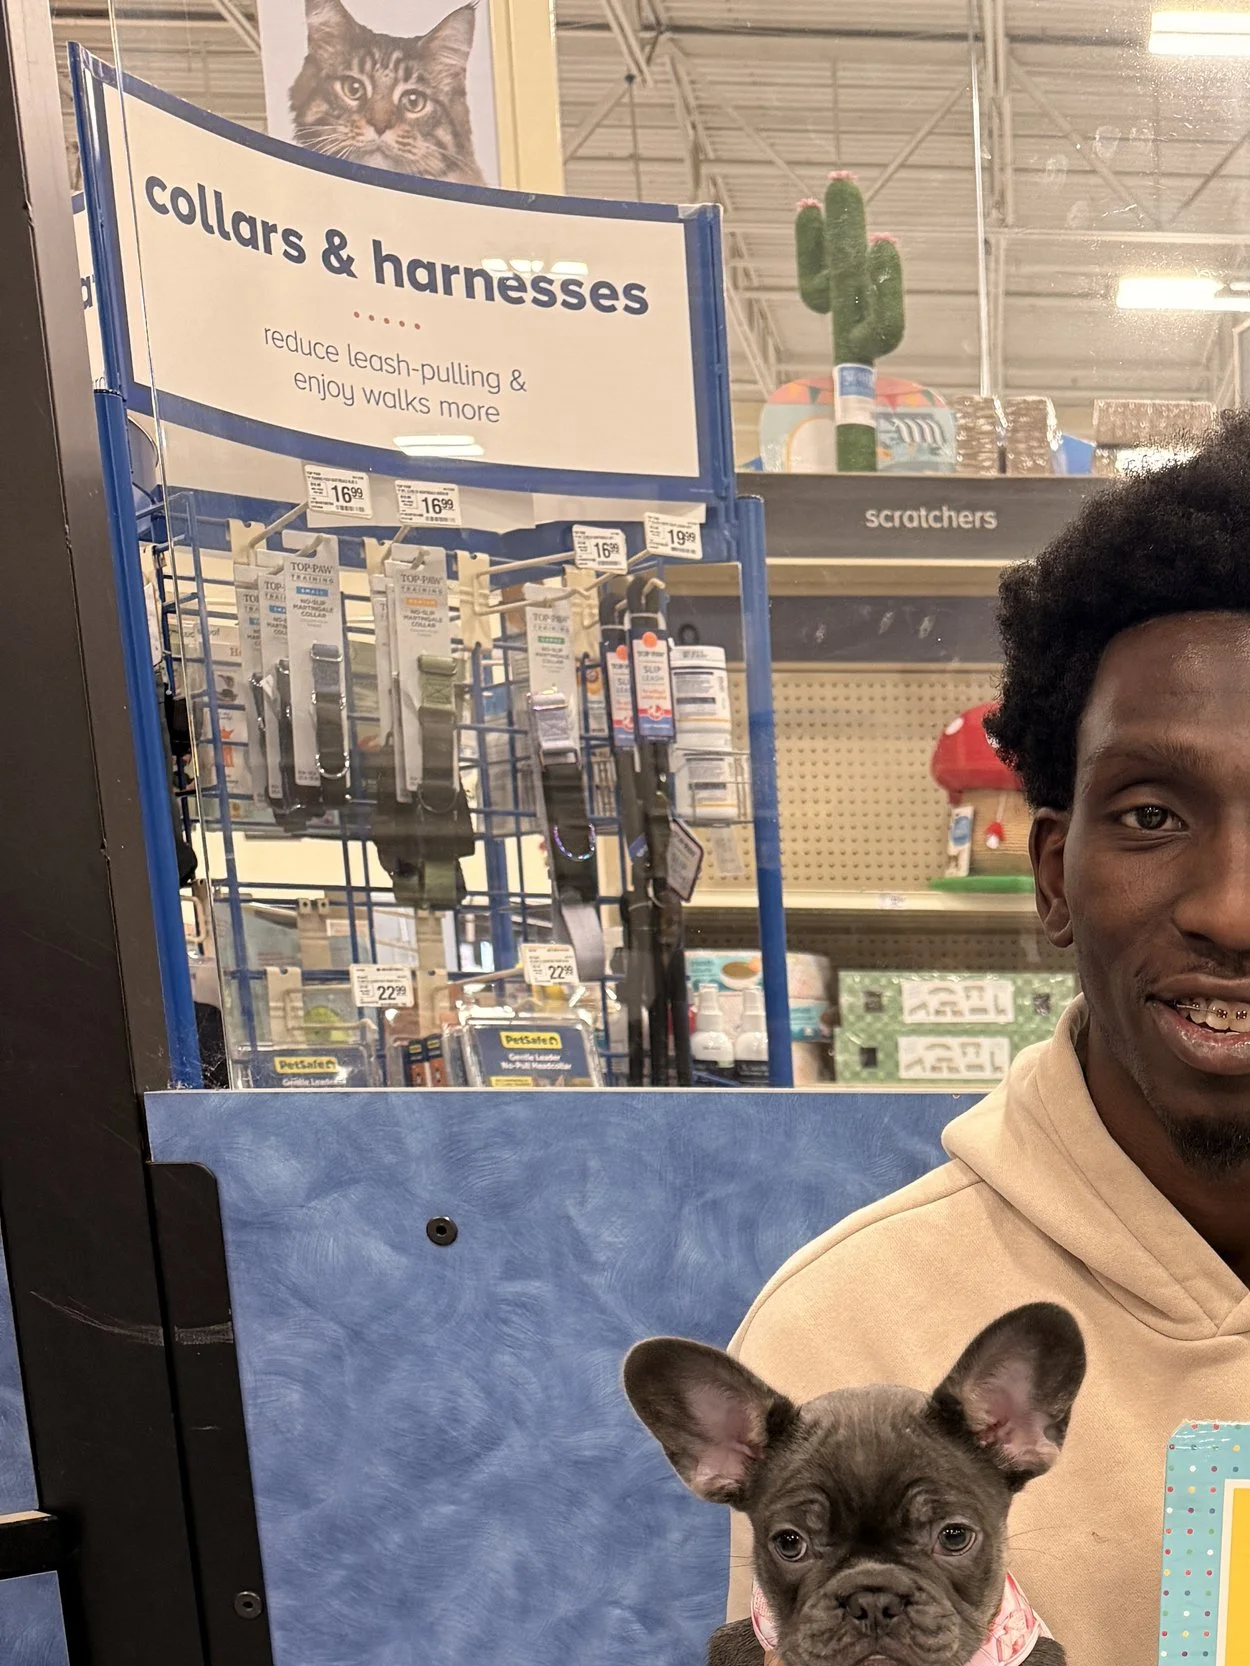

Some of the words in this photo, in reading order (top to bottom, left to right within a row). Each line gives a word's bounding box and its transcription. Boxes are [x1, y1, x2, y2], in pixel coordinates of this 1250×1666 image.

[145, 175, 306, 264] collars
[322, 229, 358, 279] &
[372, 239, 649, 315] harnesses
[264, 327, 340, 363] reduce
[347, 343, 501, 395] leash-pulling
[510, 369, 527, 392] &
[293, 372, 355, 407] enjoy
[361, 386, 431, 415] walks
[439, 400, 501, 423] more
[864, 504, 998, 529] scratchers
[505, 1034, 548, 1045] PetSafe
[279, 1059, 324, 1070] PetSafe
